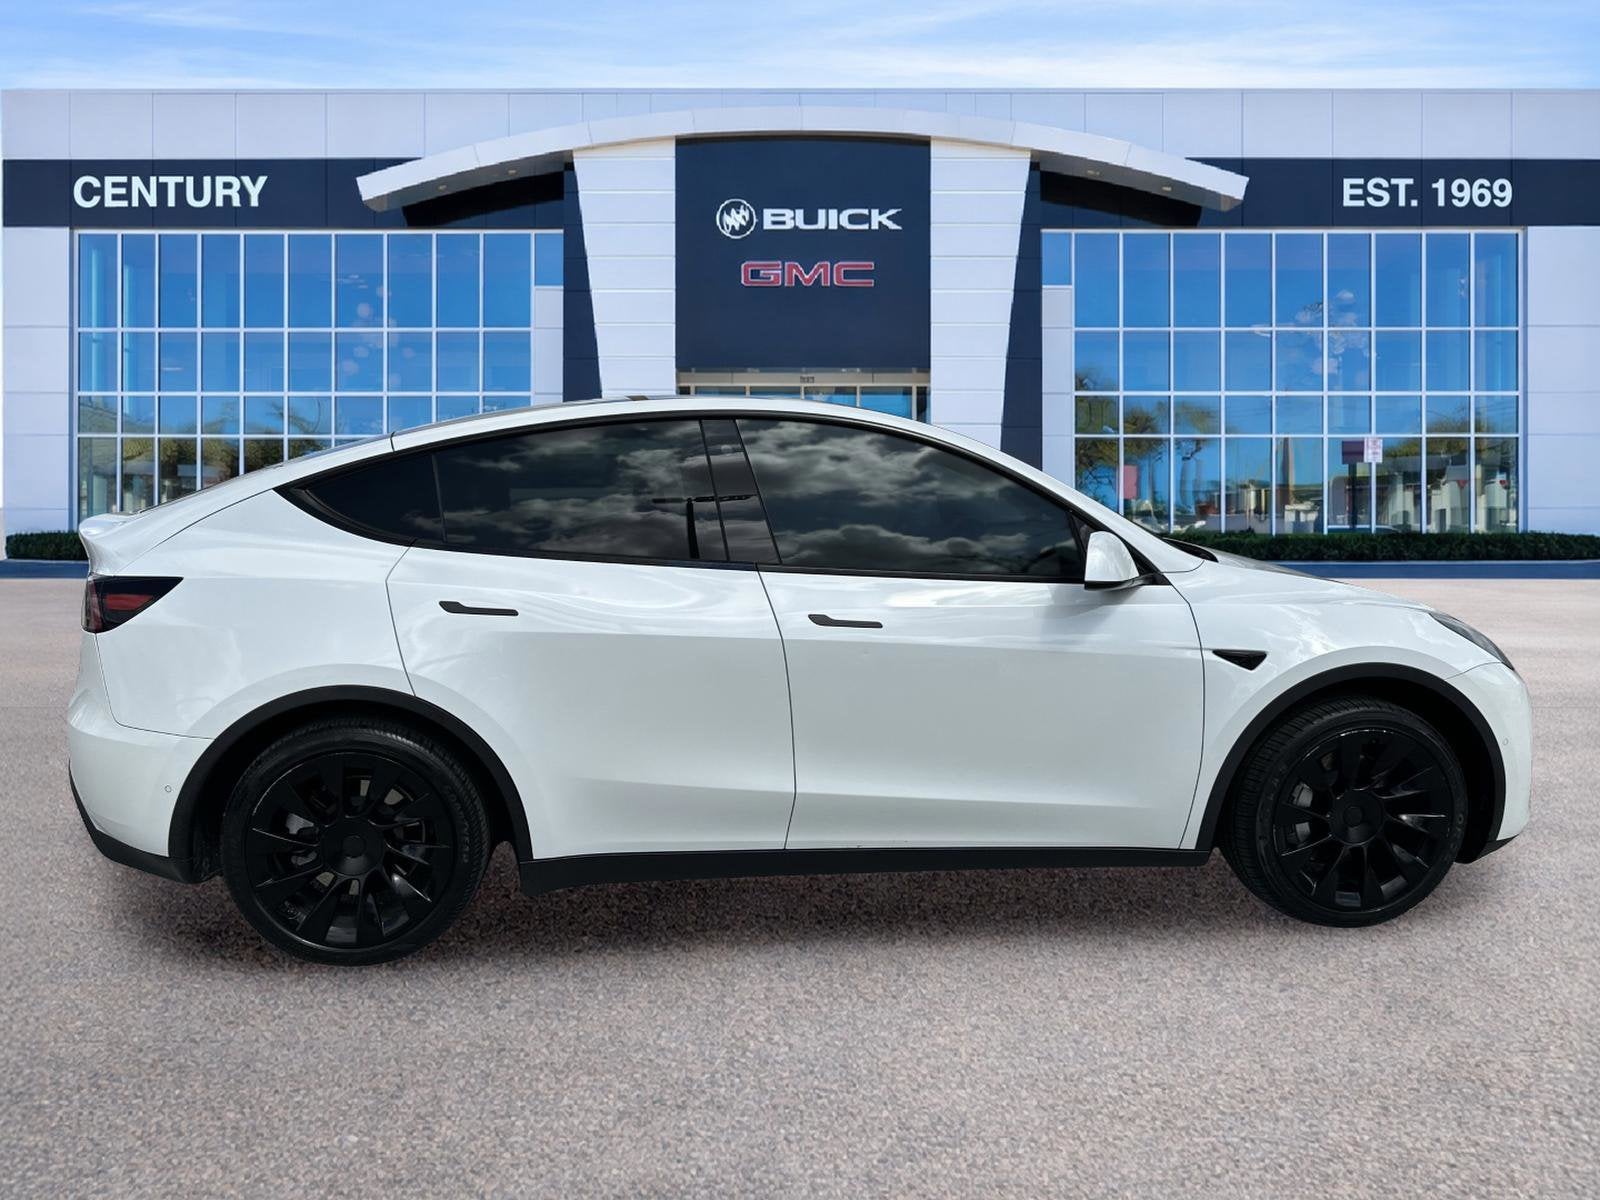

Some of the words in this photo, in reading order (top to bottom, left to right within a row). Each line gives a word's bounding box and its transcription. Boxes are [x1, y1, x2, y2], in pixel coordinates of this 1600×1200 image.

[73, 175, 268, 208] CENTURY
[1342, 177, 1418, 208] EST.
[1431, 177, 1513, 208] 1969
[763, 208, 902, 230] BUICK
[740, 260, 875, 287] GMC
